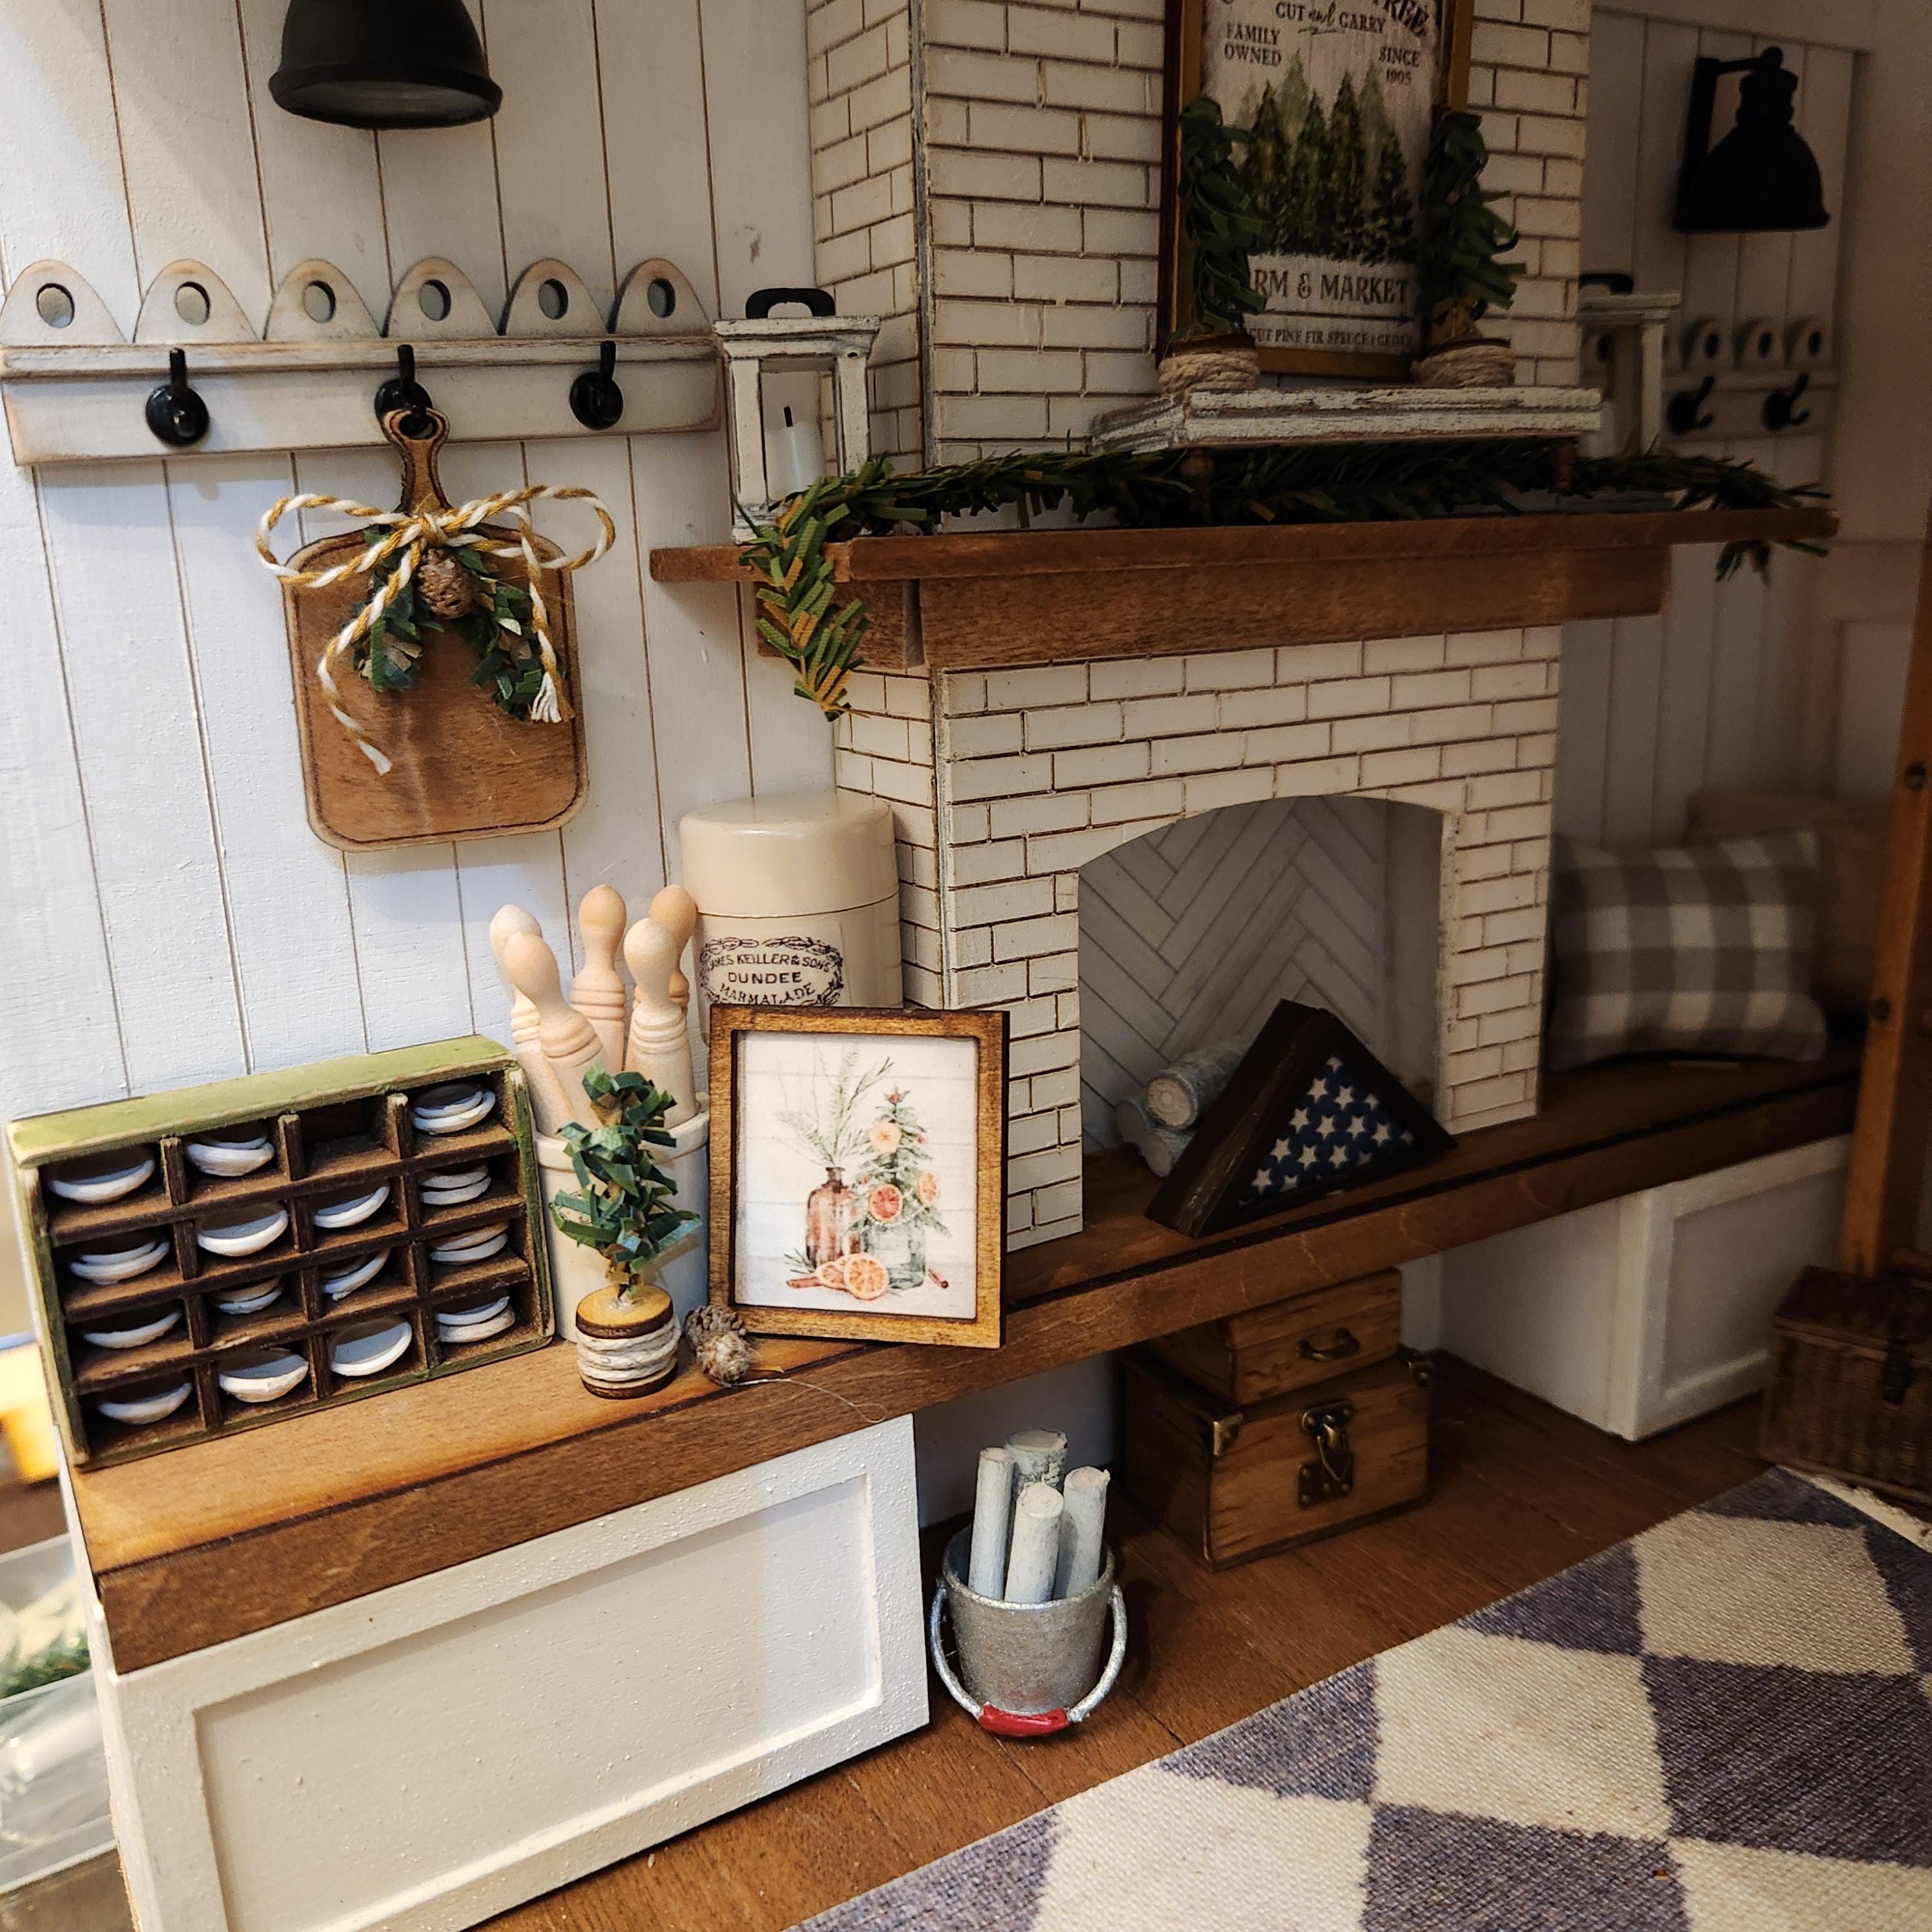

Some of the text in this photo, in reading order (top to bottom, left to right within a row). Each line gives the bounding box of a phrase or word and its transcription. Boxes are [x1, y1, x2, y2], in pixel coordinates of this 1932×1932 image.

[1276, 2, 1386, 34] CUT and CARRY
[1227, 21, 1280, 45] FAMILY
[1225, 43, 1282, 66] OWNED
[1379, 46, 1420, 68] SINCE
[1254, 269, 1410, 304] RM & MARKET
[791, 954, 799, 965] &
[728, 971, 802, 984] DUNDEE
[720, 982, 816, 1005] MARMALADE
